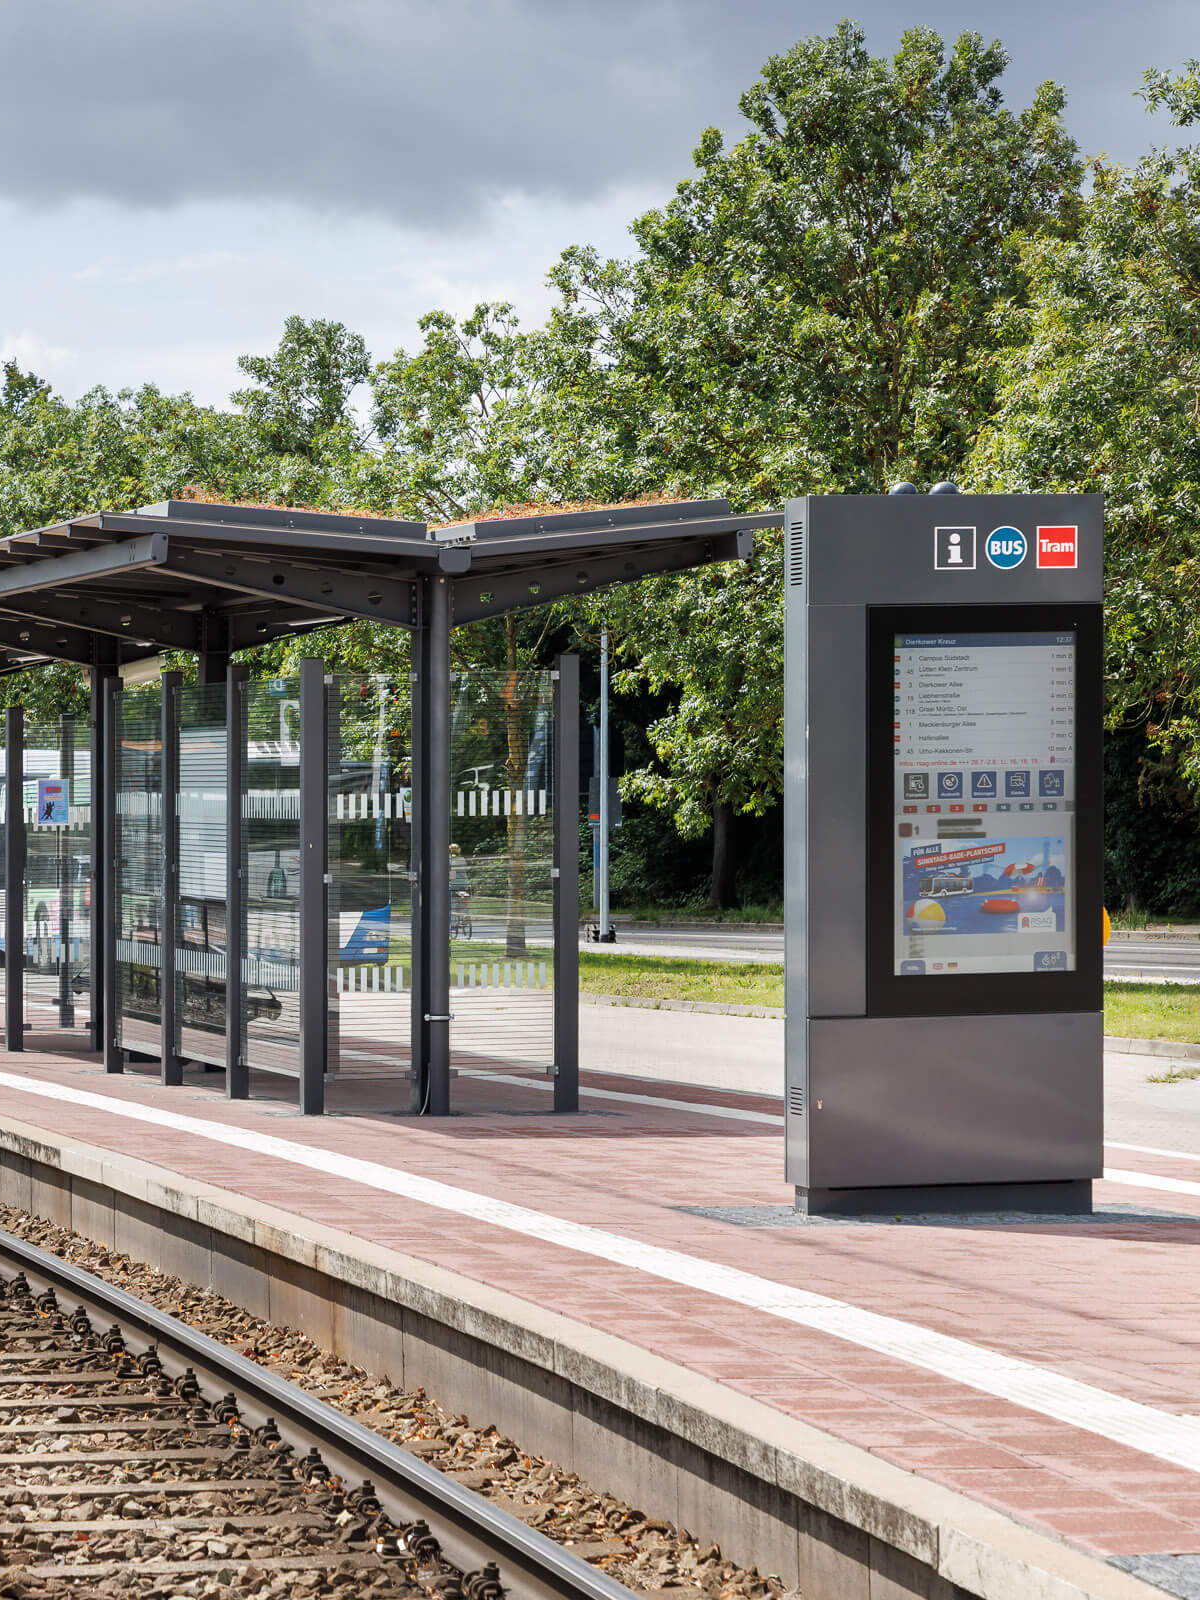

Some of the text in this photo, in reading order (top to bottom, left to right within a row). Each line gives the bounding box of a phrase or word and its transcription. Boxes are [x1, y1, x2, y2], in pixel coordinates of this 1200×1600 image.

[990, 540, 1023, 555] BUS
[1040, 540, 1074, 552] Tram
[913, 848, 924, 856] FÜR
